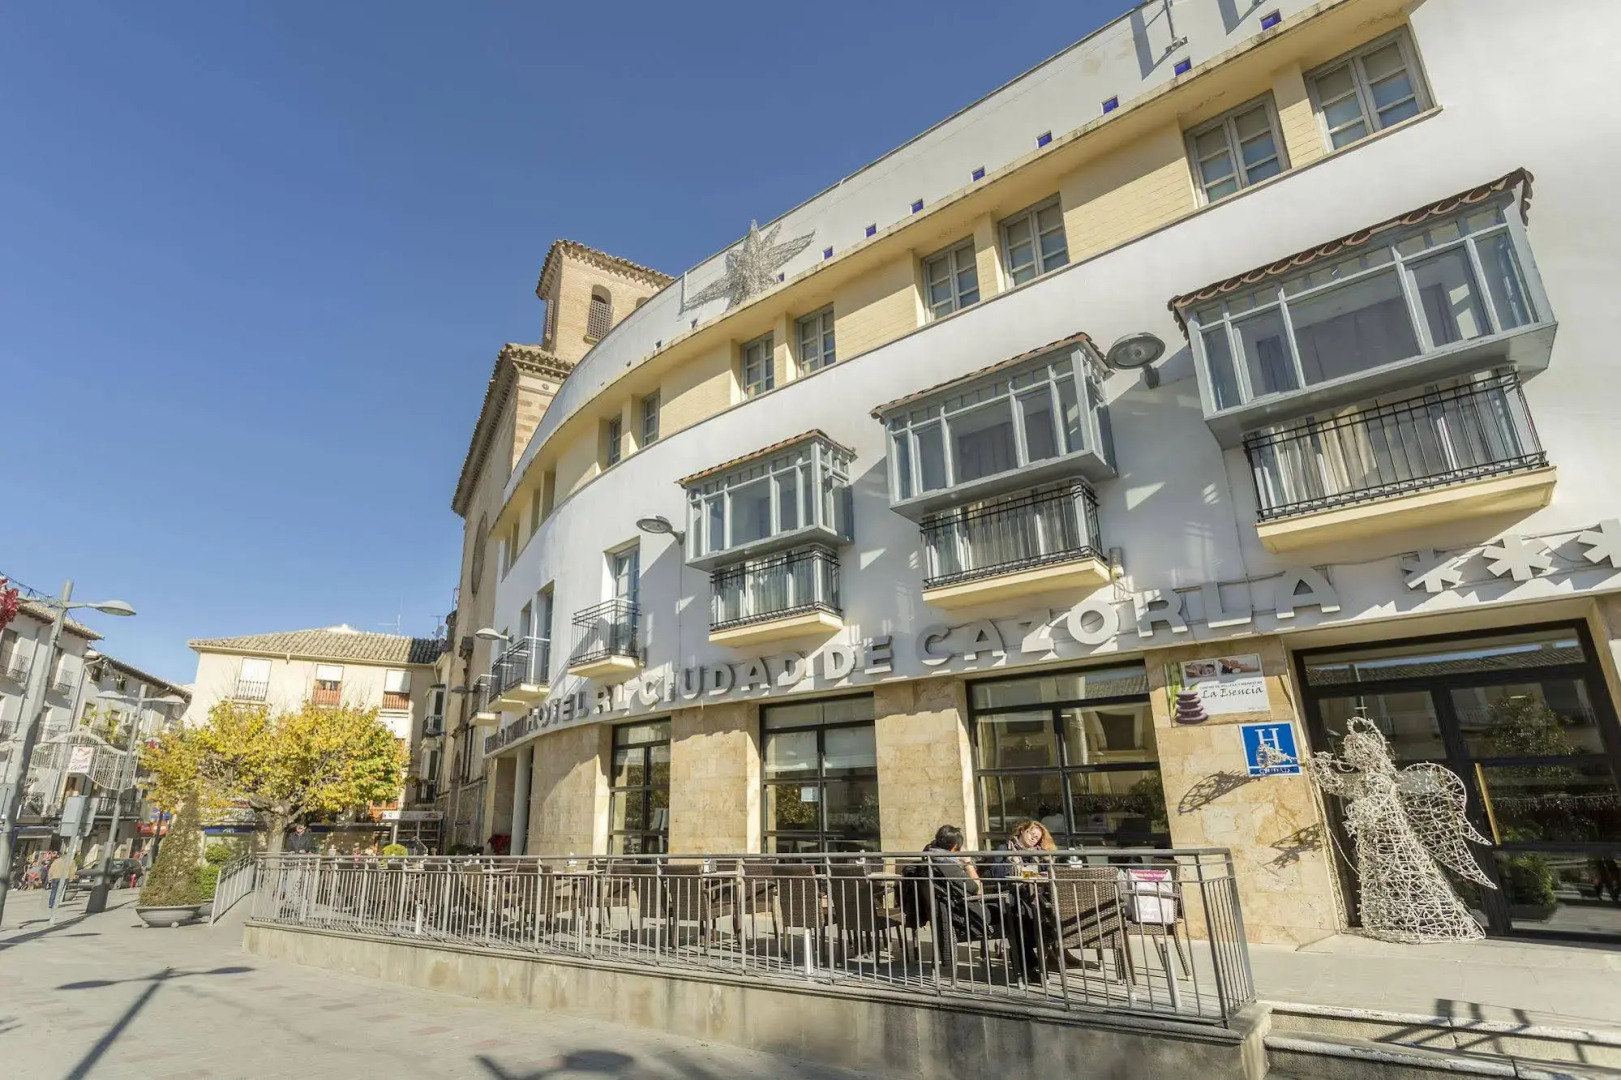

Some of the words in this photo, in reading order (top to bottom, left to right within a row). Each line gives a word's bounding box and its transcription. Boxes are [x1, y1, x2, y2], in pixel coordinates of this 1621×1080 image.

[526, 691, 590, 732] HOTEL
[638, 650, 808, 706] CIUDAD
[824, 634, 893, 681] DE
[916, 565, 1341, 666] CAZORLA
[1202, 690, 1217, 698] La
[1219, 684, 1264, 698] Esencia
[1254, 727, 1283, 751] H
